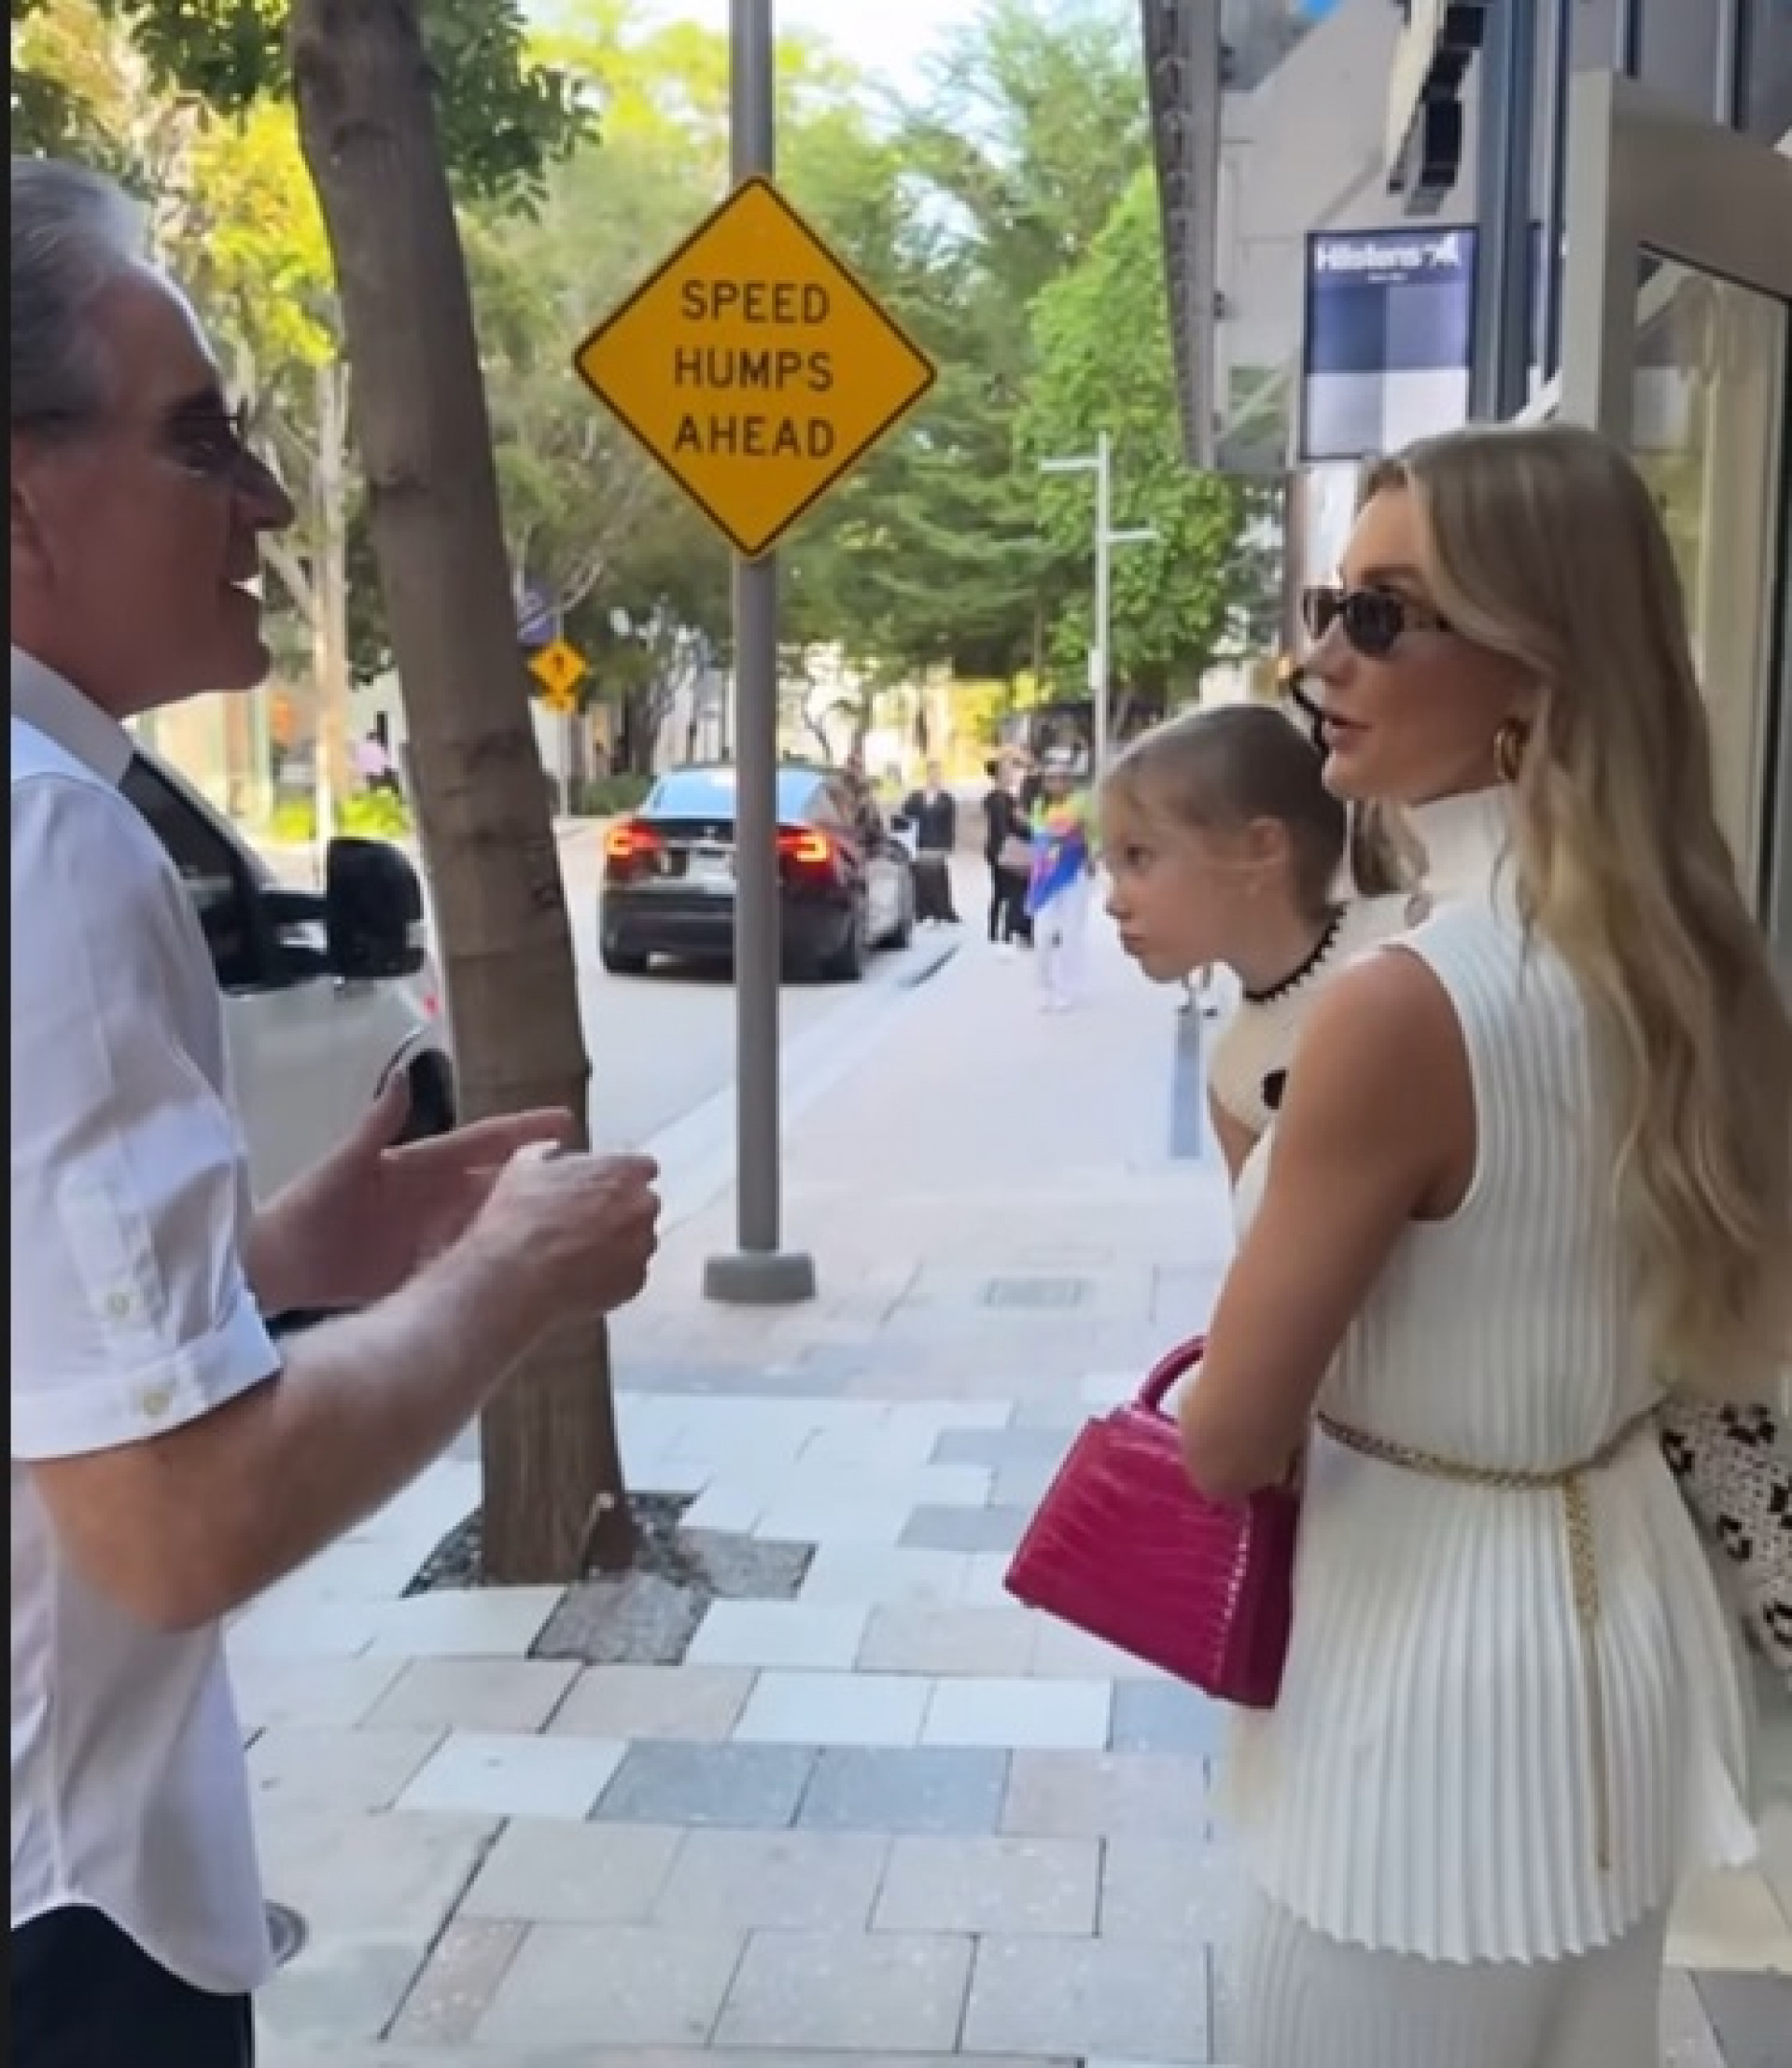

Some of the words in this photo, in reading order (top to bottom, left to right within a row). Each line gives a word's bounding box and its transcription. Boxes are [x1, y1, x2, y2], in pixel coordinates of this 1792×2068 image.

[681, 280, 830, 325] SPEED
[674, 346, 833, 392] HUMPS
[672, 414, 835, 458] AHEAD
